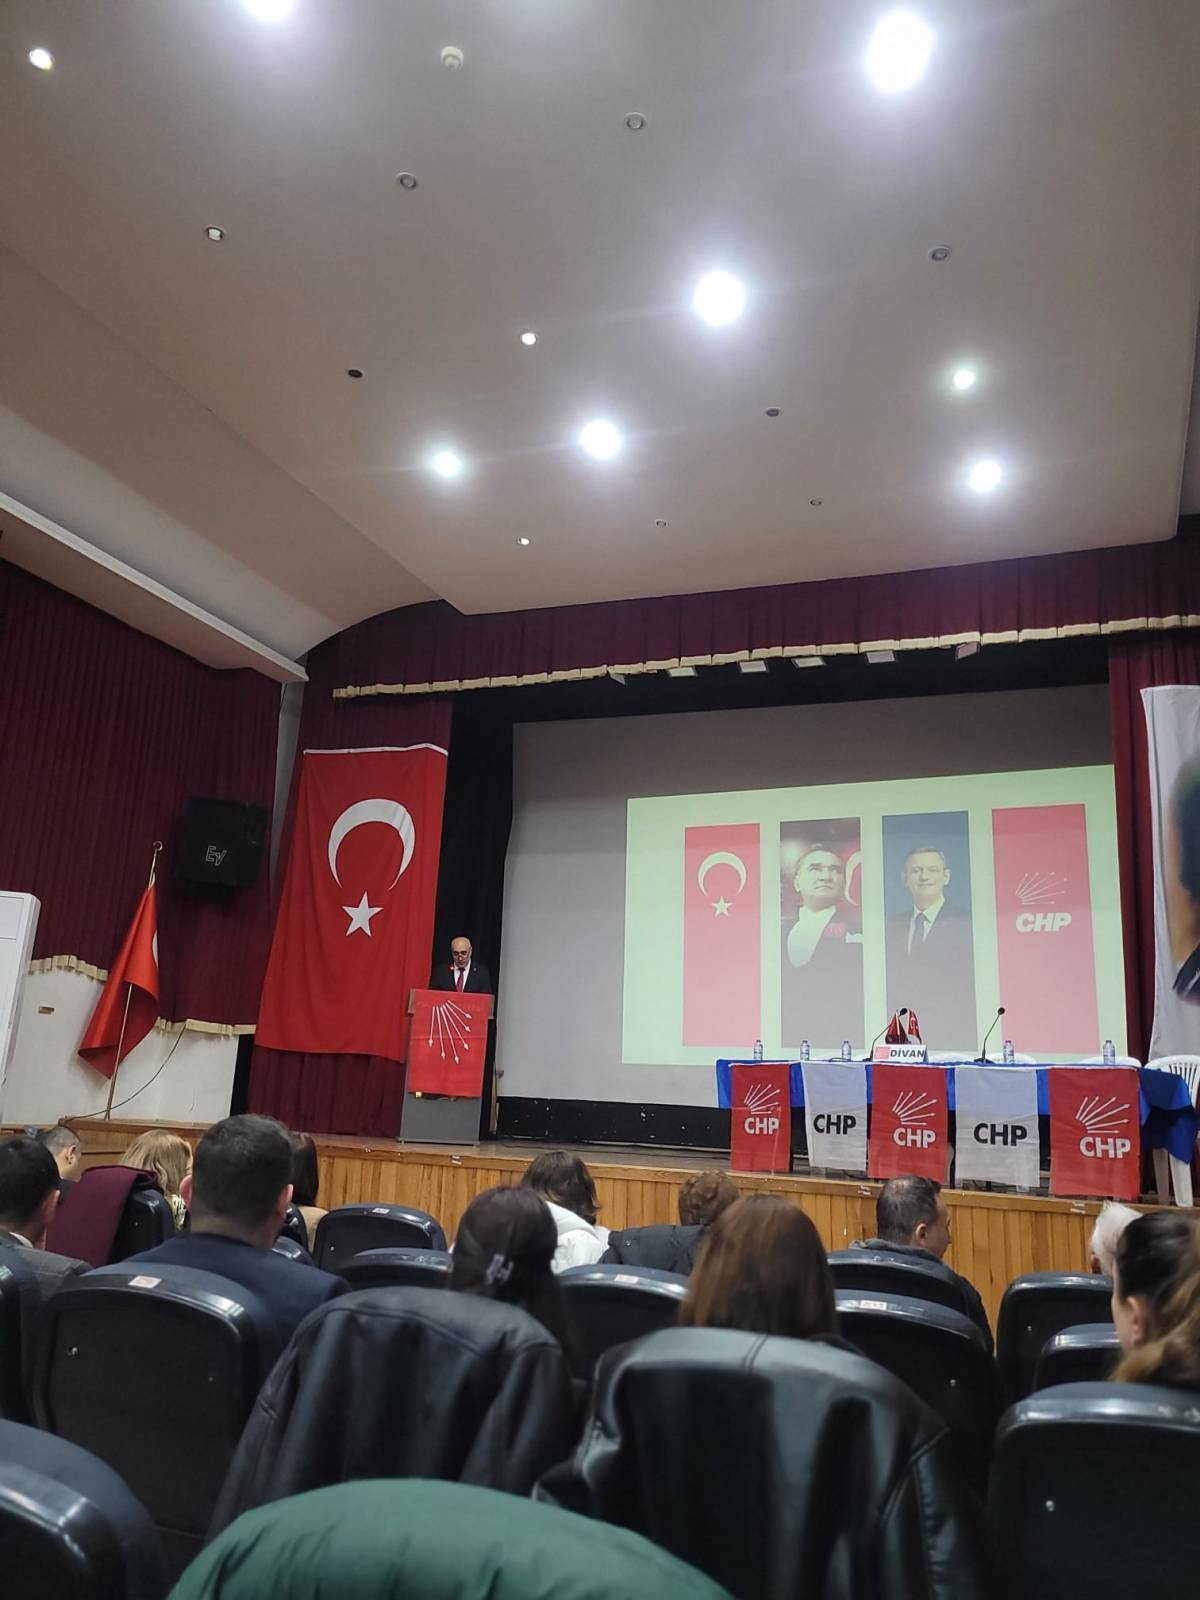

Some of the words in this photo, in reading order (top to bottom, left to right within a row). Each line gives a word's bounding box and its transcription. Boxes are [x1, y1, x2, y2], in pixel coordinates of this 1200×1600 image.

[1015, 911, 1072, 933] CHP
[890, 1047, 925, 1059] DİVAN
[743, 1117, 780, 1135] CHP
[813, 1113, 857, 1135] CHP
[973, 1123, 1027, 1147] CHP
[893, 1127, 936, 1149] CHP
[1079, 1137, 1131, 1159] CHP
